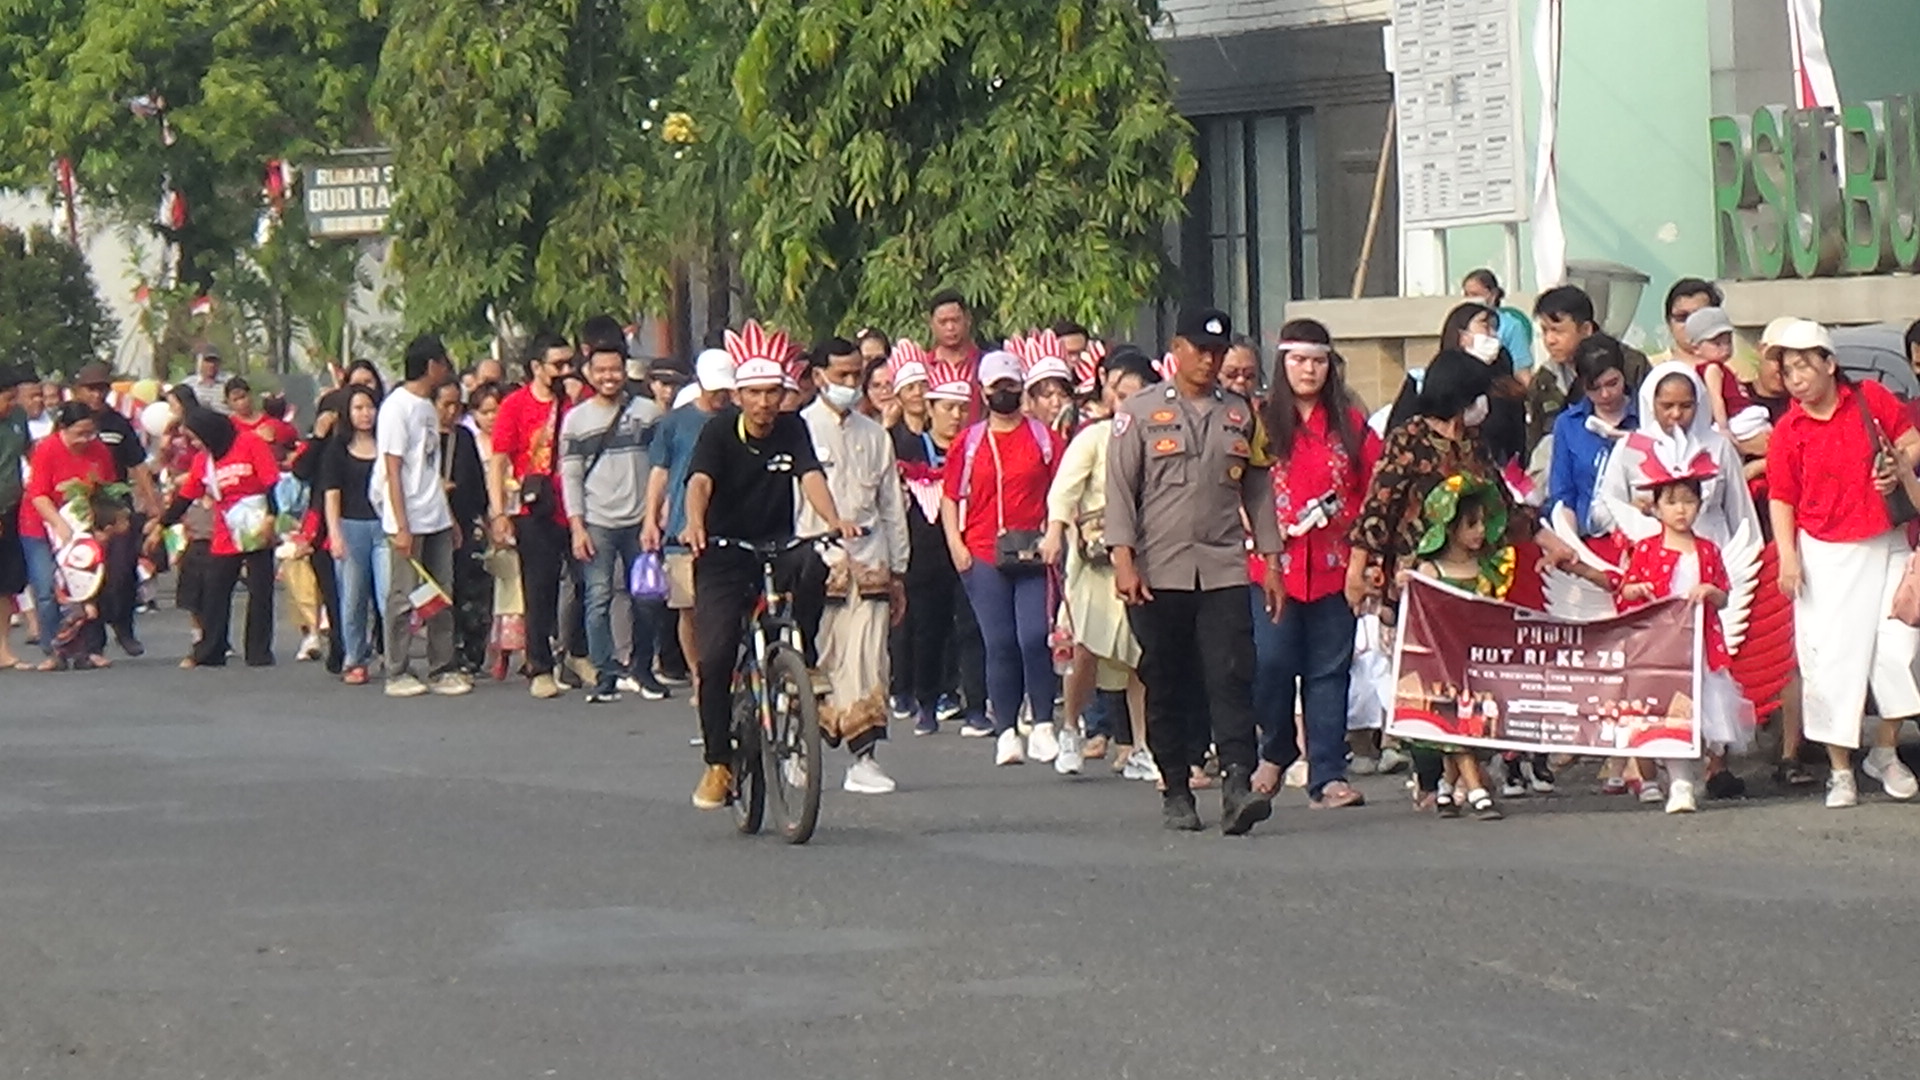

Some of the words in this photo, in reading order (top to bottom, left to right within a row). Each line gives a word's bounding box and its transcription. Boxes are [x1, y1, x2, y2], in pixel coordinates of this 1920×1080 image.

[316, 167, 379, 185] RUMAH
[383, 165, 394, 182] S
[309, 187, 355, 212] BUDI
[361, 185, 391, 209] RA
[1709, 103, 1824, 280] RSU
[1842, 96, 1920, 273] BU
[1470, 647, 1513, 663] HUT
[1524, 648, 1546, 665] RI
[1556, 649, 1584, 667] KE
[1597, 650, 1625, 668] 79
